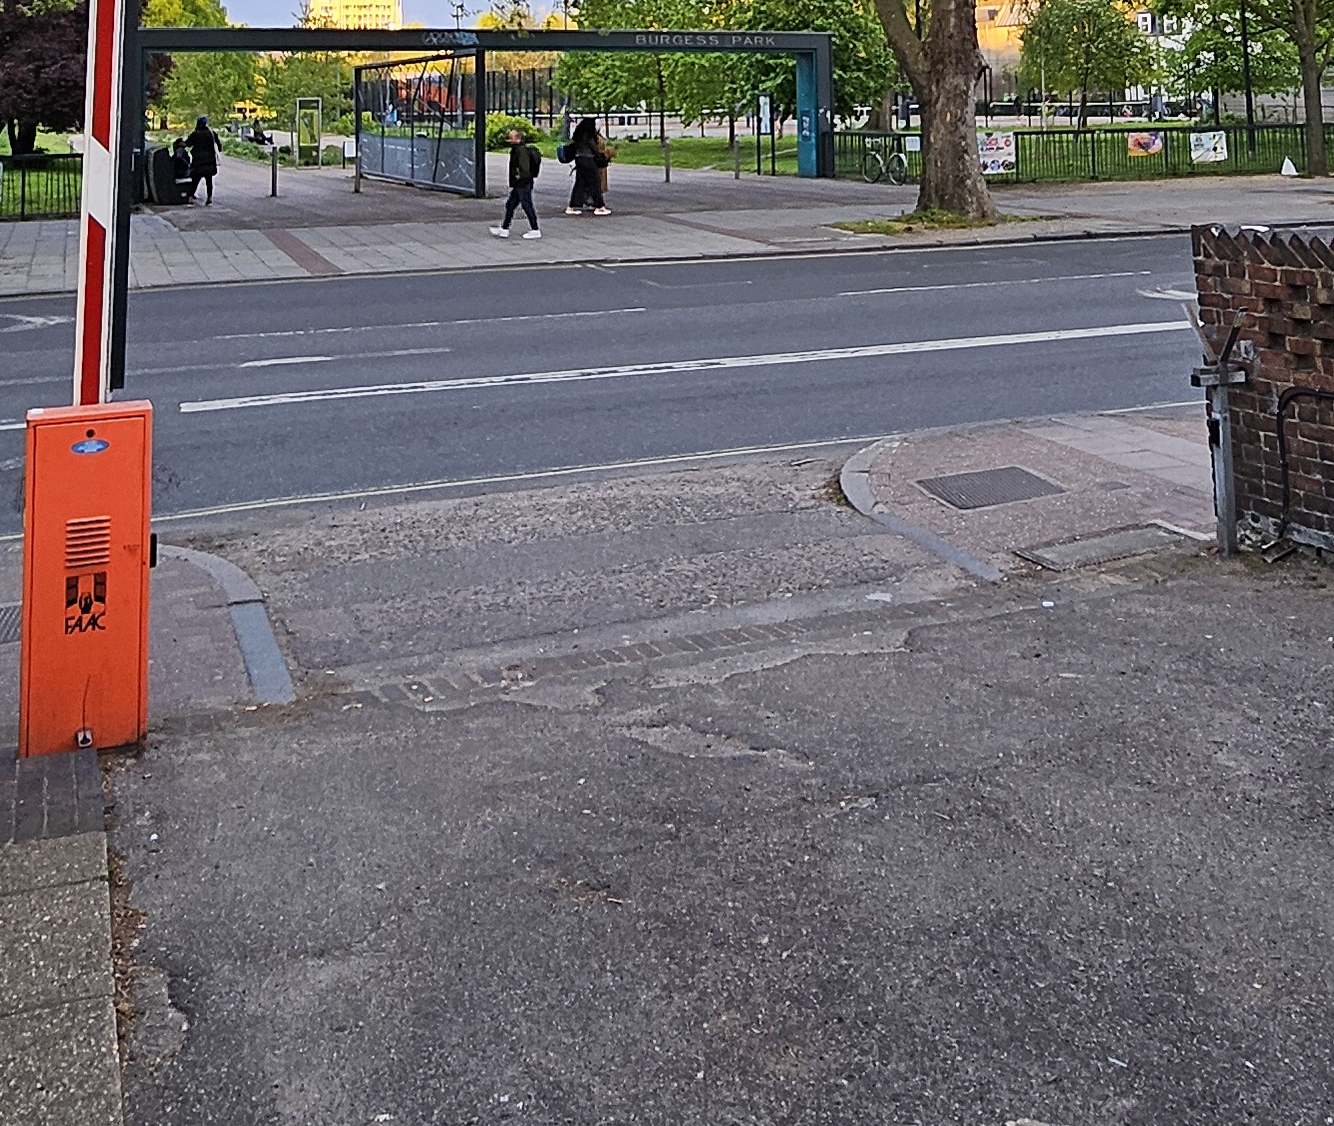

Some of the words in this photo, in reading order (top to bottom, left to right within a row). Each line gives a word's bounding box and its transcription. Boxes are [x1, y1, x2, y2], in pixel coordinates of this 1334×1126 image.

[635, 34, 720, 46] BURGESS
[731, 35, 776, 46] PARK
[65, 611, 107, 635] FAAC
